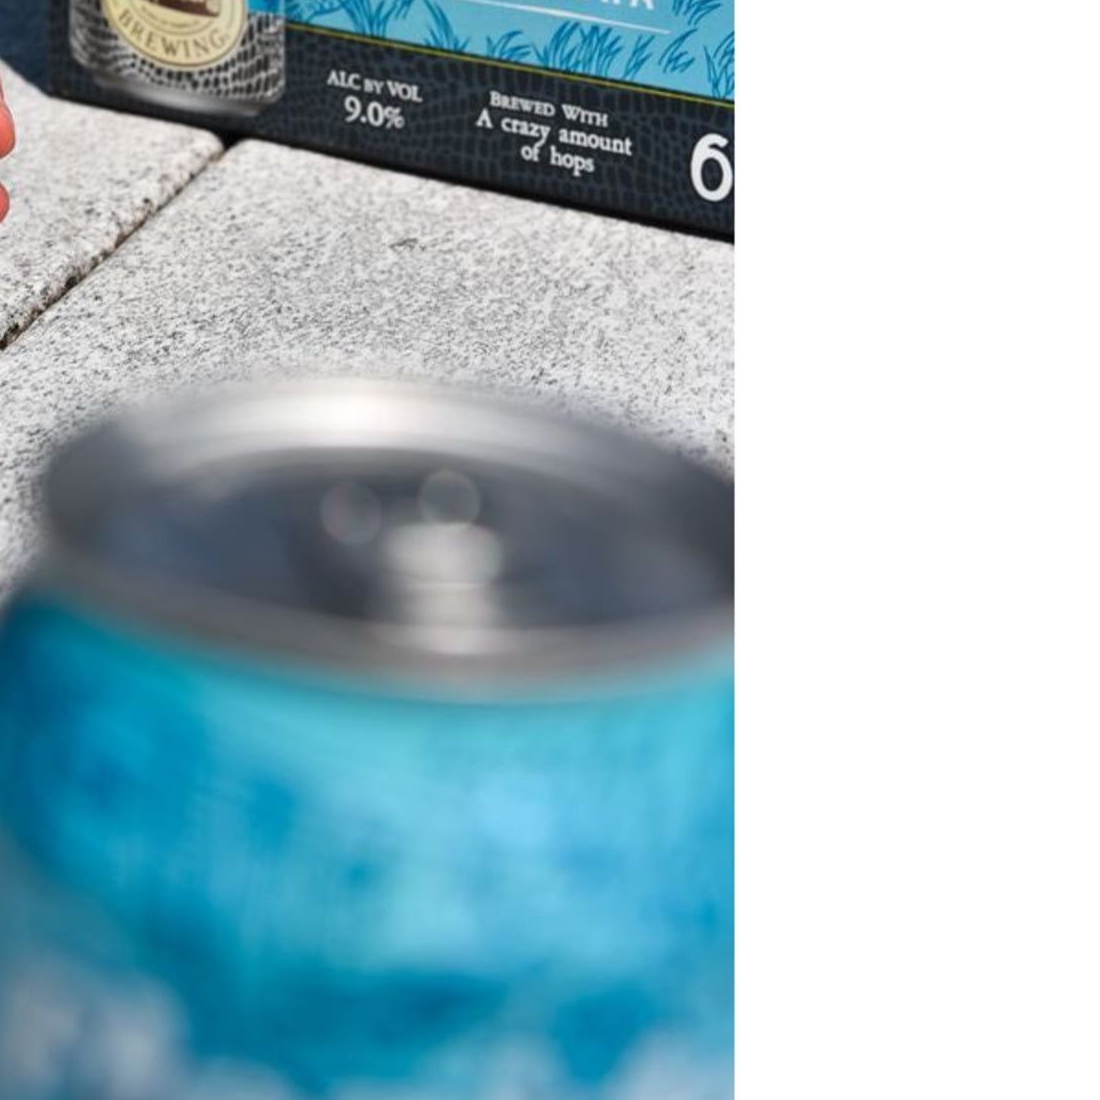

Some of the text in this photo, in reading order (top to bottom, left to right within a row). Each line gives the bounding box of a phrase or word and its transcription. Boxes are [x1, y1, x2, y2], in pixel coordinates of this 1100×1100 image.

[117, 8, 227, 58] BREWING
[326, 69, 423, 103] ALC BY VOL
[344, 95, 405, 129] 9.0%
[489, 90, 609, 127] BREWED WITH
[475, 107, 633, 156] A crazy amount
[520, 144, 595, 177] of hops
[690, 132, 734, 202] 6
